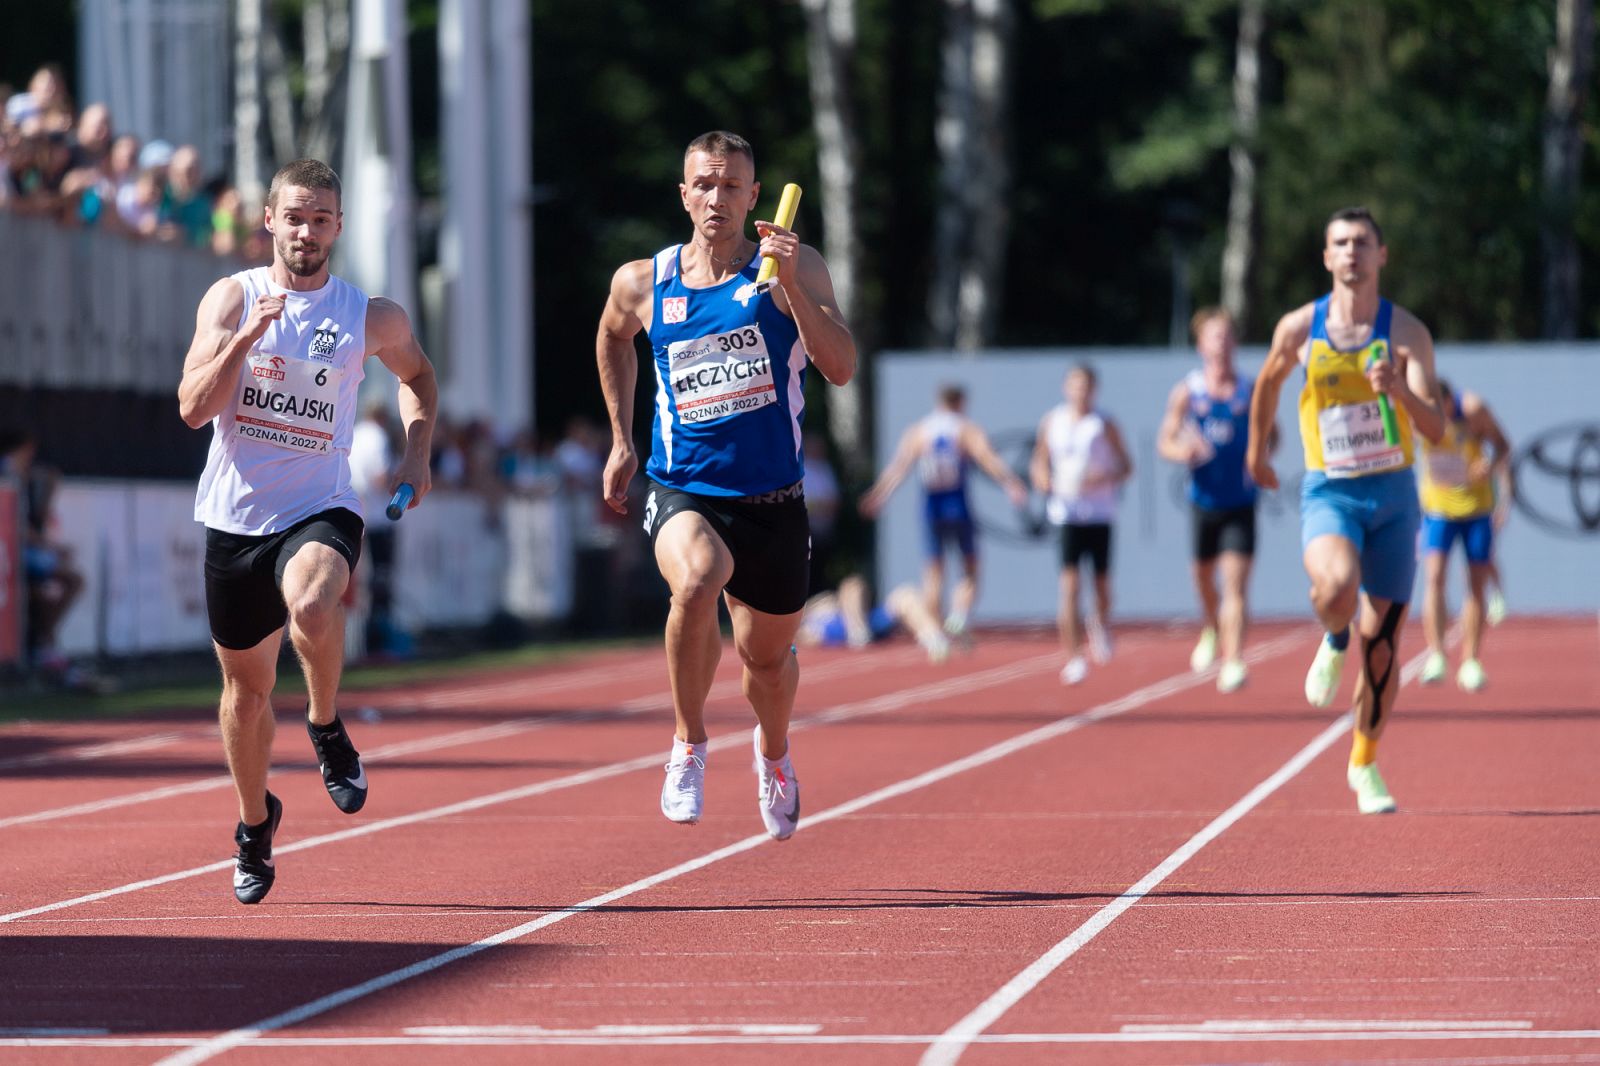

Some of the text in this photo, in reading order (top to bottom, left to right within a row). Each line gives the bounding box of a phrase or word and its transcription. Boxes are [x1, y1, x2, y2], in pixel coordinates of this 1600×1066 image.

[314, 340, 334, 349] AZS
[718, 328, 758, 352] 303
[254, 367, 285, 381] ORLEN
[314, 368, 328, 386] 6
[675, 357, 768, 393] ŁĘCZYCKI
[242, 387, 334, 423] BUGAJSKI
[684, 397, 760, 421] POZNAŃ 2022
[240, 425, 318, 449] POZNAŃ 2022
